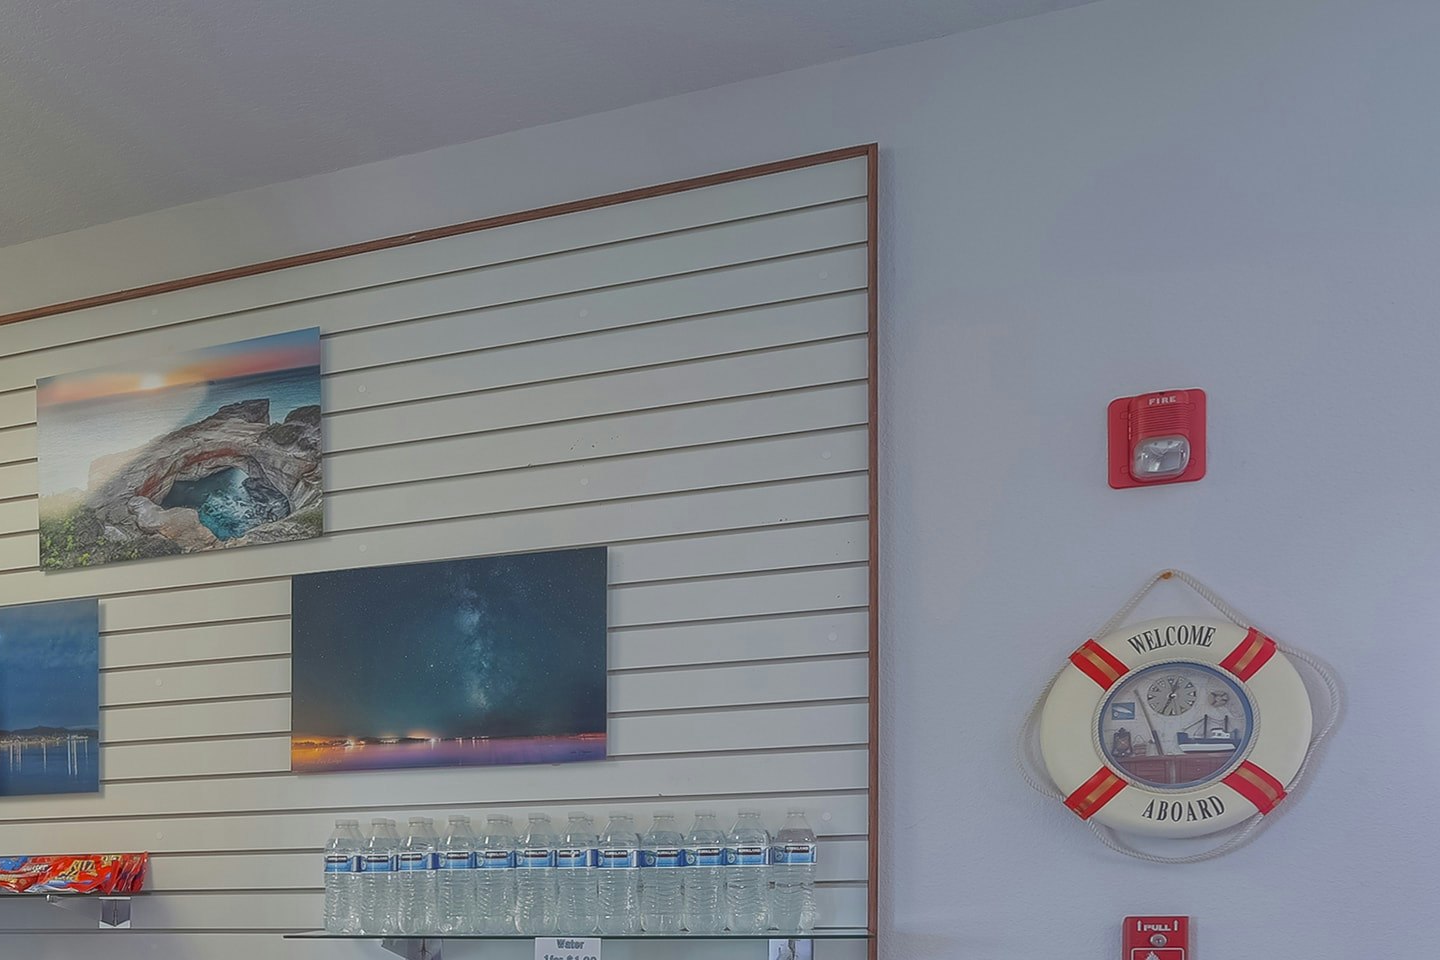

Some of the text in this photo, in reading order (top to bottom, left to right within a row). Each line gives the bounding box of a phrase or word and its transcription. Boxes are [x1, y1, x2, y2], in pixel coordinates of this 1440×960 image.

[1148, 396, 1176, 405] FIRE
[1127, 624, 1216, 655] WELCOME
[1141, 795, 1226, 822] ABOARD
[1143, 924, 1171, 932] PULL
[556, 939, 585, 949] Water
